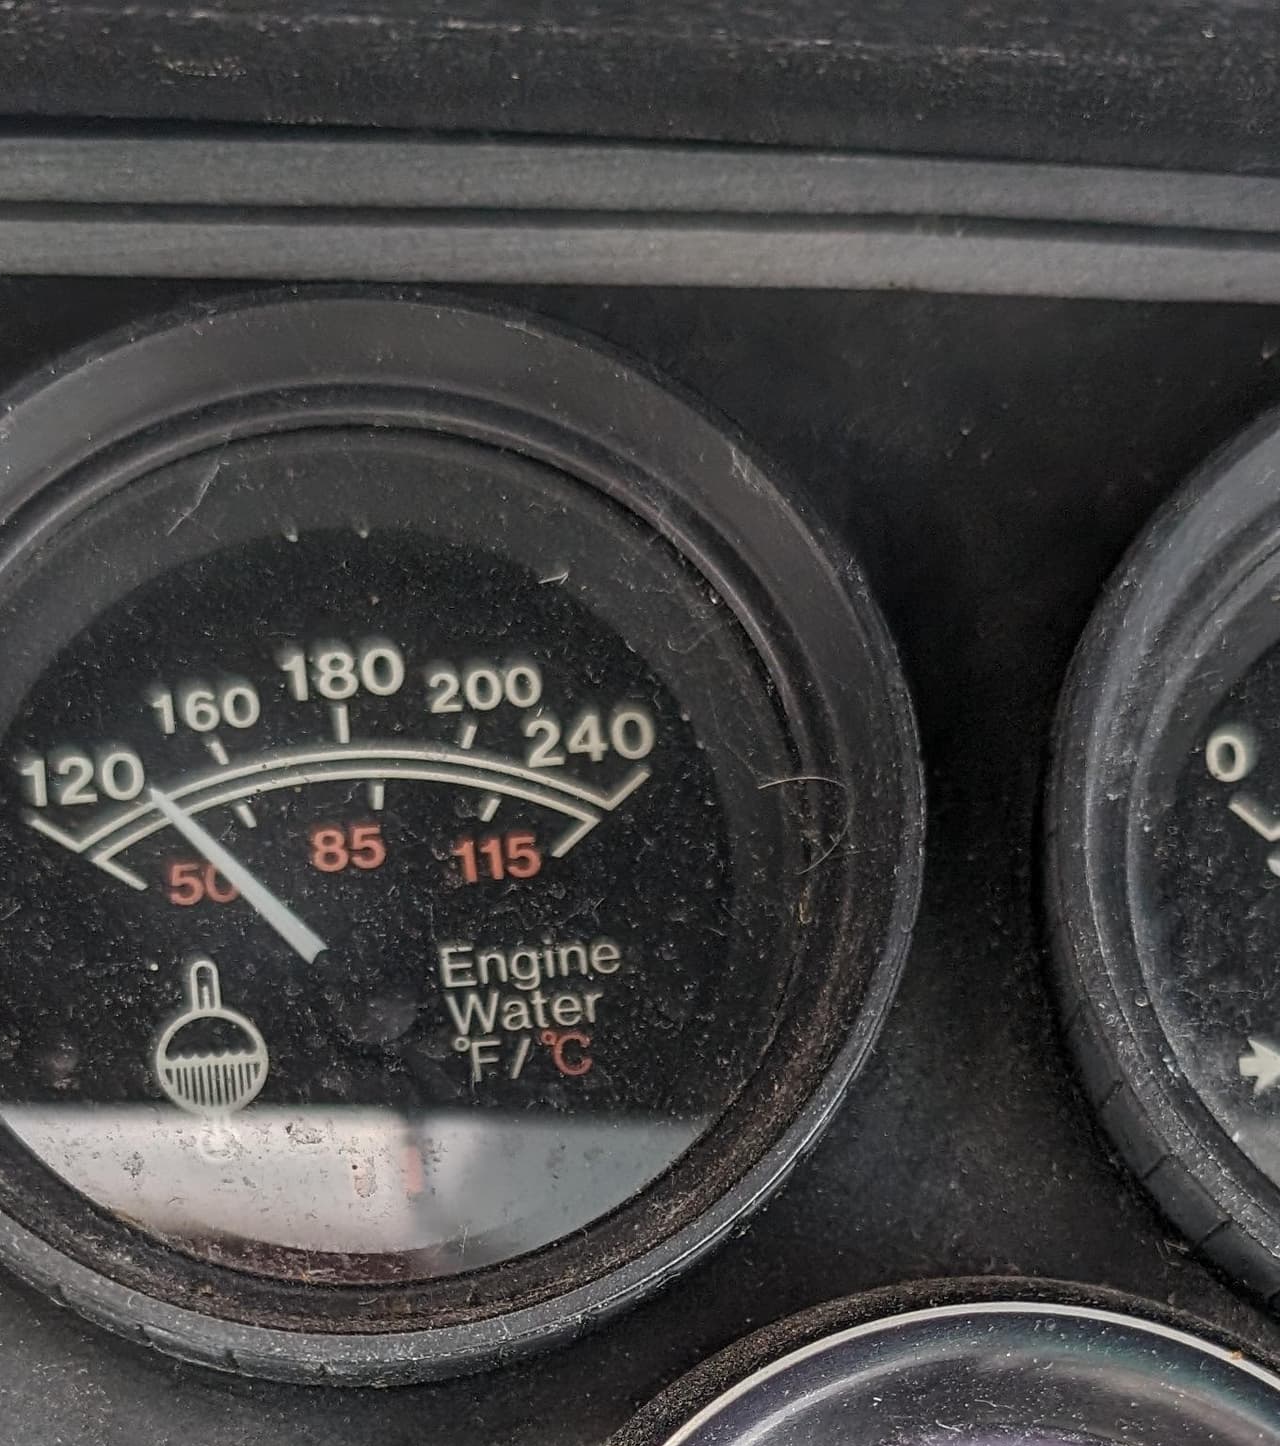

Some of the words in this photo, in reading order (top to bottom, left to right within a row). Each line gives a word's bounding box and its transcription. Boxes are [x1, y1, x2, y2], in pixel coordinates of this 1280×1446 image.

[282, 647, 405, 701] 180
[428, 665, 543, 714] 200
[152, 686, 261, 735] 160
[525, 711, 656, 769] 240
[1206, 732, 1253, 783] 0
[20, 751, 145, 807] 120
[312, 825, 386, 872] 85
[453, 834, 542, 884] 115
[169, 862, 240, 906] 50
[440, 938, 620, 990] Engine
[444, 990, 604, 1036] Water
